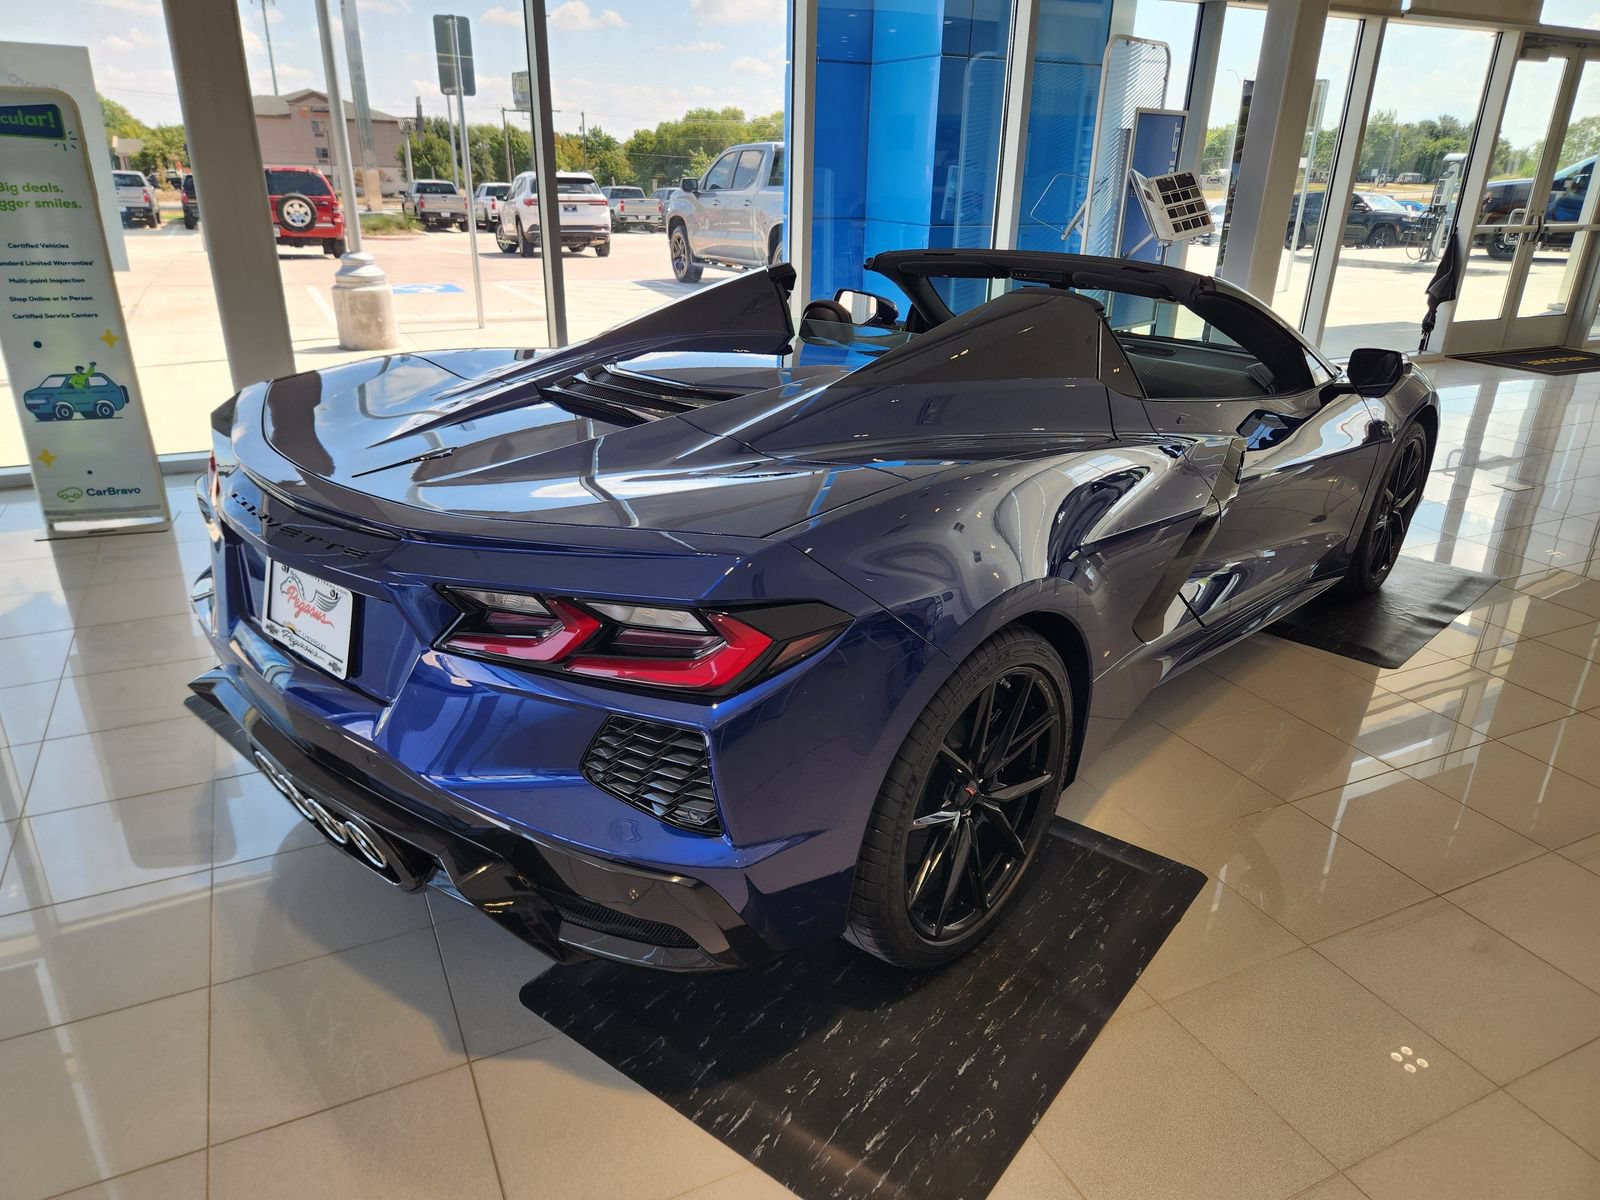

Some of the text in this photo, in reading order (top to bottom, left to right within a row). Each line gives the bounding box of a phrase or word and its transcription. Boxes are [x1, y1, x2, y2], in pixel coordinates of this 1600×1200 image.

[22, 182, 64, 193] deals.
[34, 198, 82, 208] smiles.
[12, 312, 43, 320] Certified
[86, 486, 142, 497] CarBravo
[286, 584, 333, 627] Pegasus
